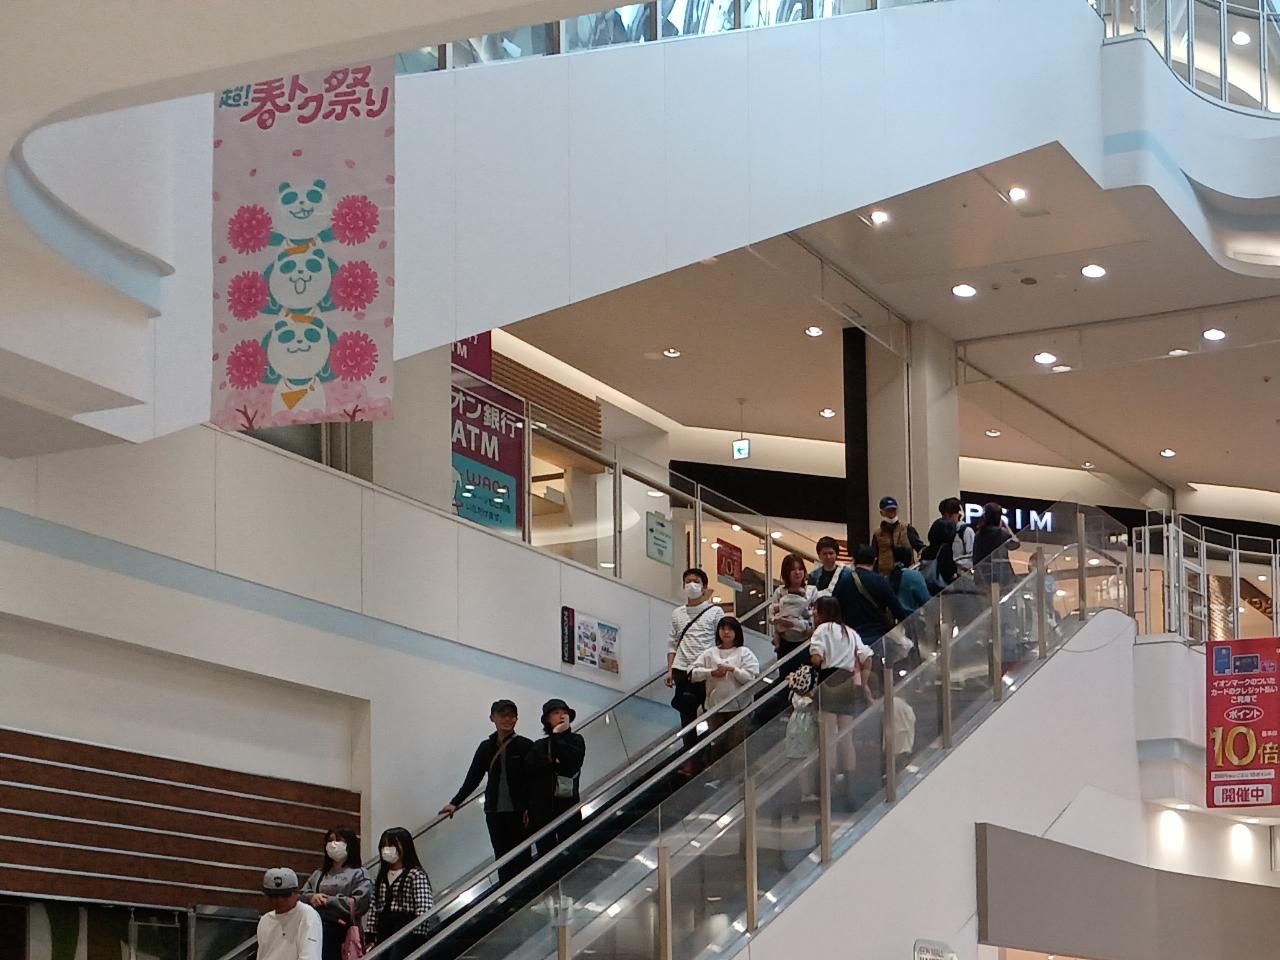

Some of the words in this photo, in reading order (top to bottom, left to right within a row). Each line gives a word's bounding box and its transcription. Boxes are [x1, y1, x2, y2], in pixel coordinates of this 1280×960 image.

[452, 419, 500, 461] ATM
[1228, 708, 1261, 720] ポイント
[1221, 786, 1265, 804] 開催中
